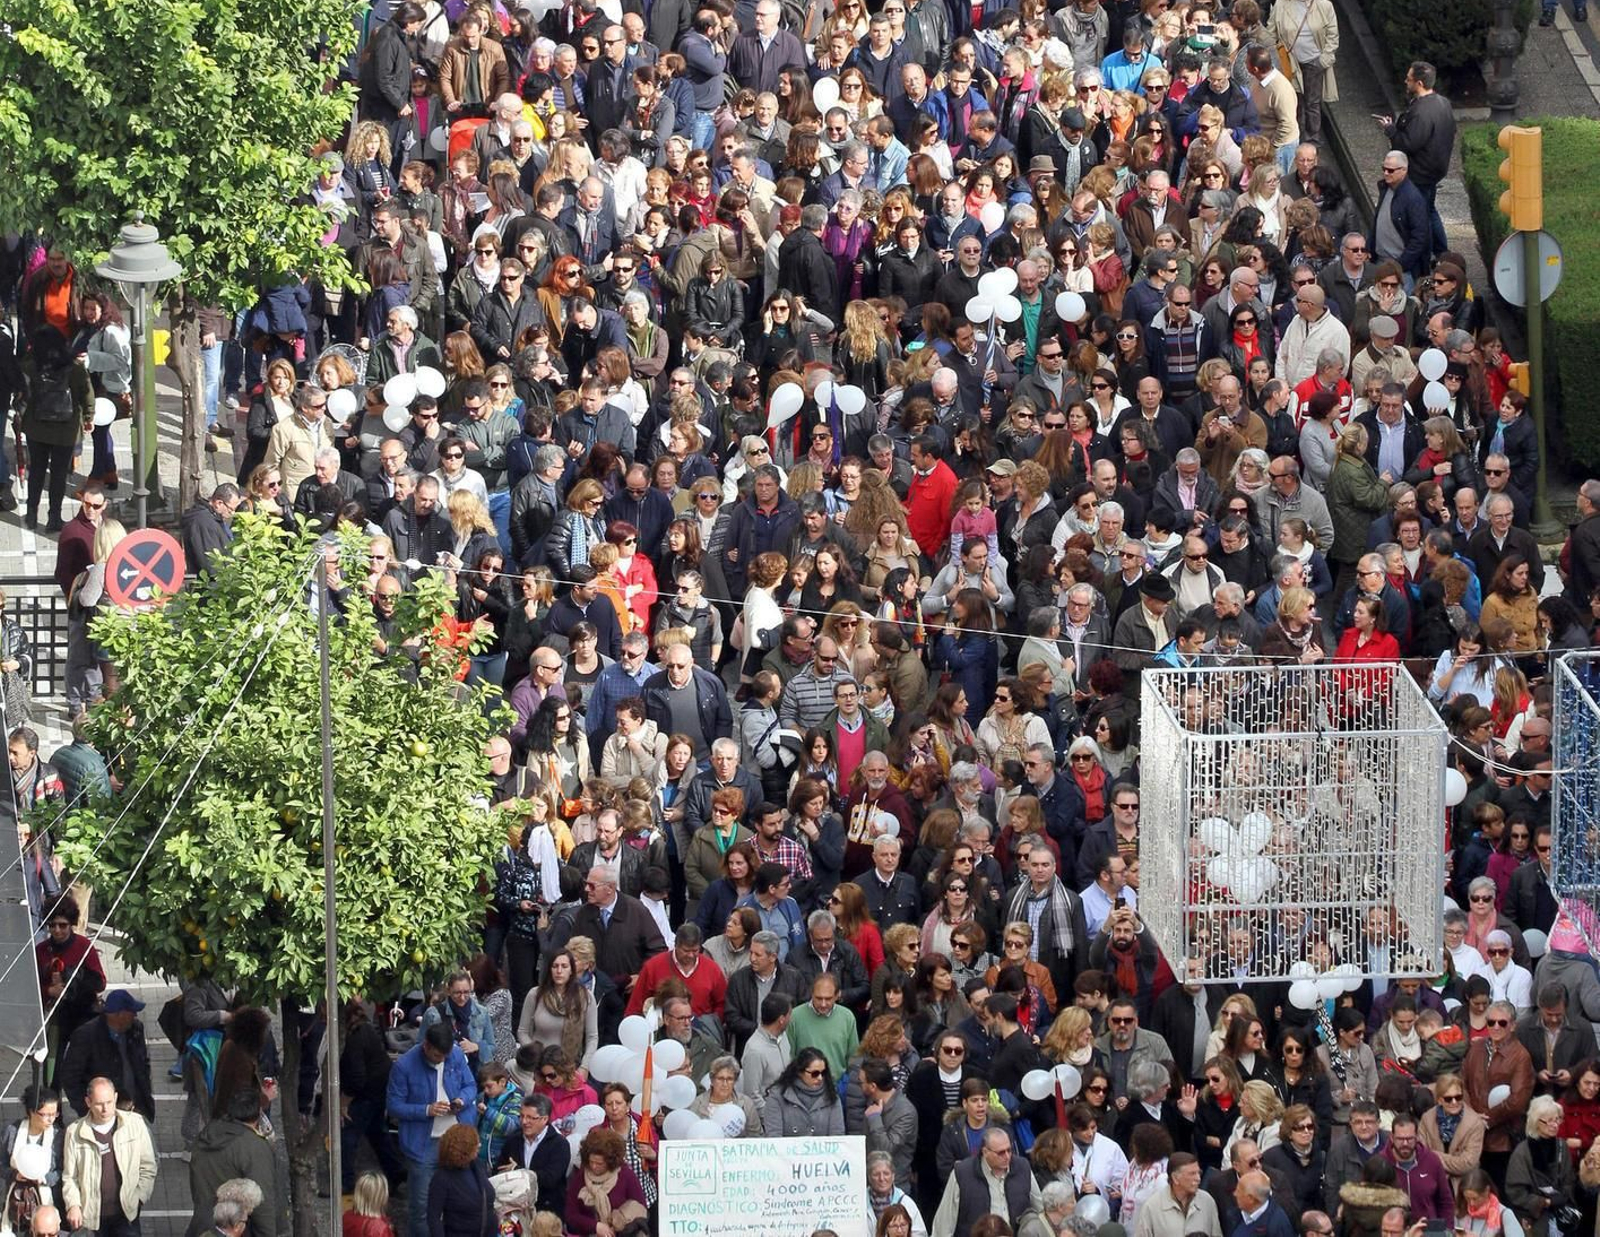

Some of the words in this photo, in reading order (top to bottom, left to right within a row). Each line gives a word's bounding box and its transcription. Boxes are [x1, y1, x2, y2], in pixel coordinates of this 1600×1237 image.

[803, 1141, 839, 1153] SALUD
[675, 1151, 709, 1161] JUNTA
[669, 1169, 711, 1179] SEVILLA
[792, 1160, 850, 1179] HUELVA
[767, 1183, 807, 1195] 4000
[814, 1181, 847, 1193] años
[669, 1219, 702, 1234] TTO:
